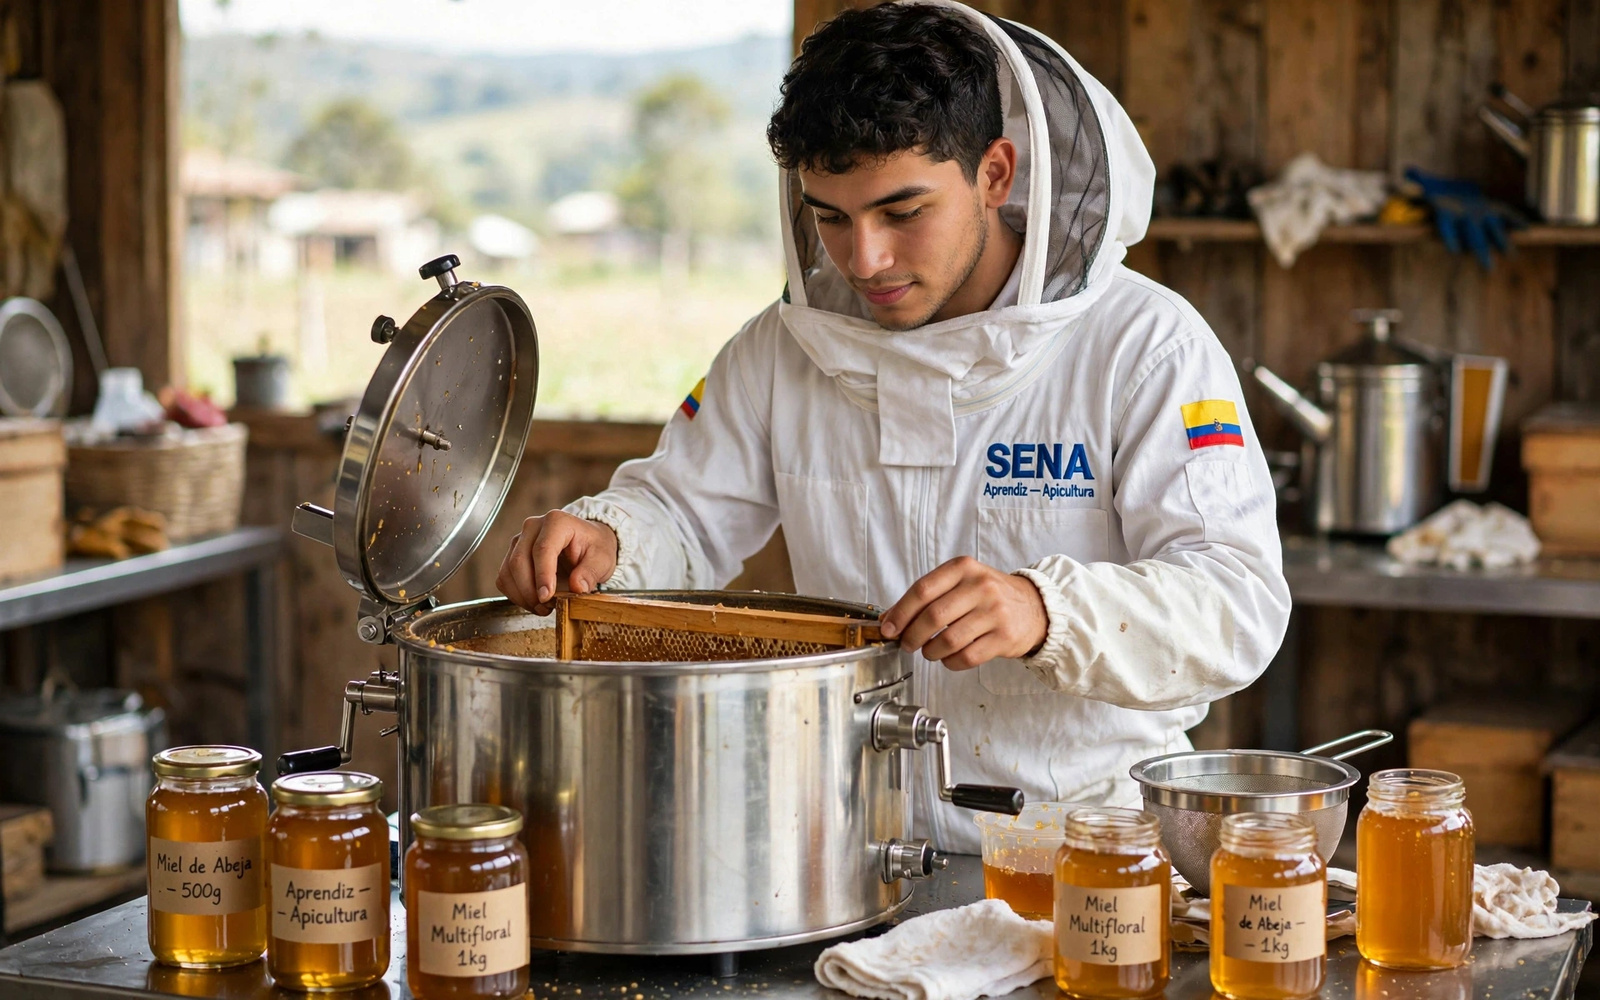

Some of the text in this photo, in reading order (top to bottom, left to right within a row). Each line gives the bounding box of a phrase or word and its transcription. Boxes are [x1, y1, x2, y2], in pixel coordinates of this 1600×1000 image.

[985, 442, 1095, 480] SENA
[983, 482, 1028, 499] Aprendiz
[1042, 483, 1095, 501] Apicultura
[156, 853, 253, 879] Miel de Abeja
[181, 882, 222, 905] 500g
[285, 881, 355, 907] Aprendiz
[1084, 895, 1118, 914] Miel
[1249, 894, 1282, 912] Miel
[289, 906, 368, 930] Apicultura
[451, 901, 487, 921] Miel
[430, 920, 511, 947] Multifloral
[1069, 916, 1146, 938] Multifloral
[1238, 914, 1253, 930] de
[1256, 914, 1292, 936] Abeja
[1090, 940, 1118, 963] 1kg
[1260, 937, 1290, 960] 1kg
[457, 949, 488, 972] 1kg
